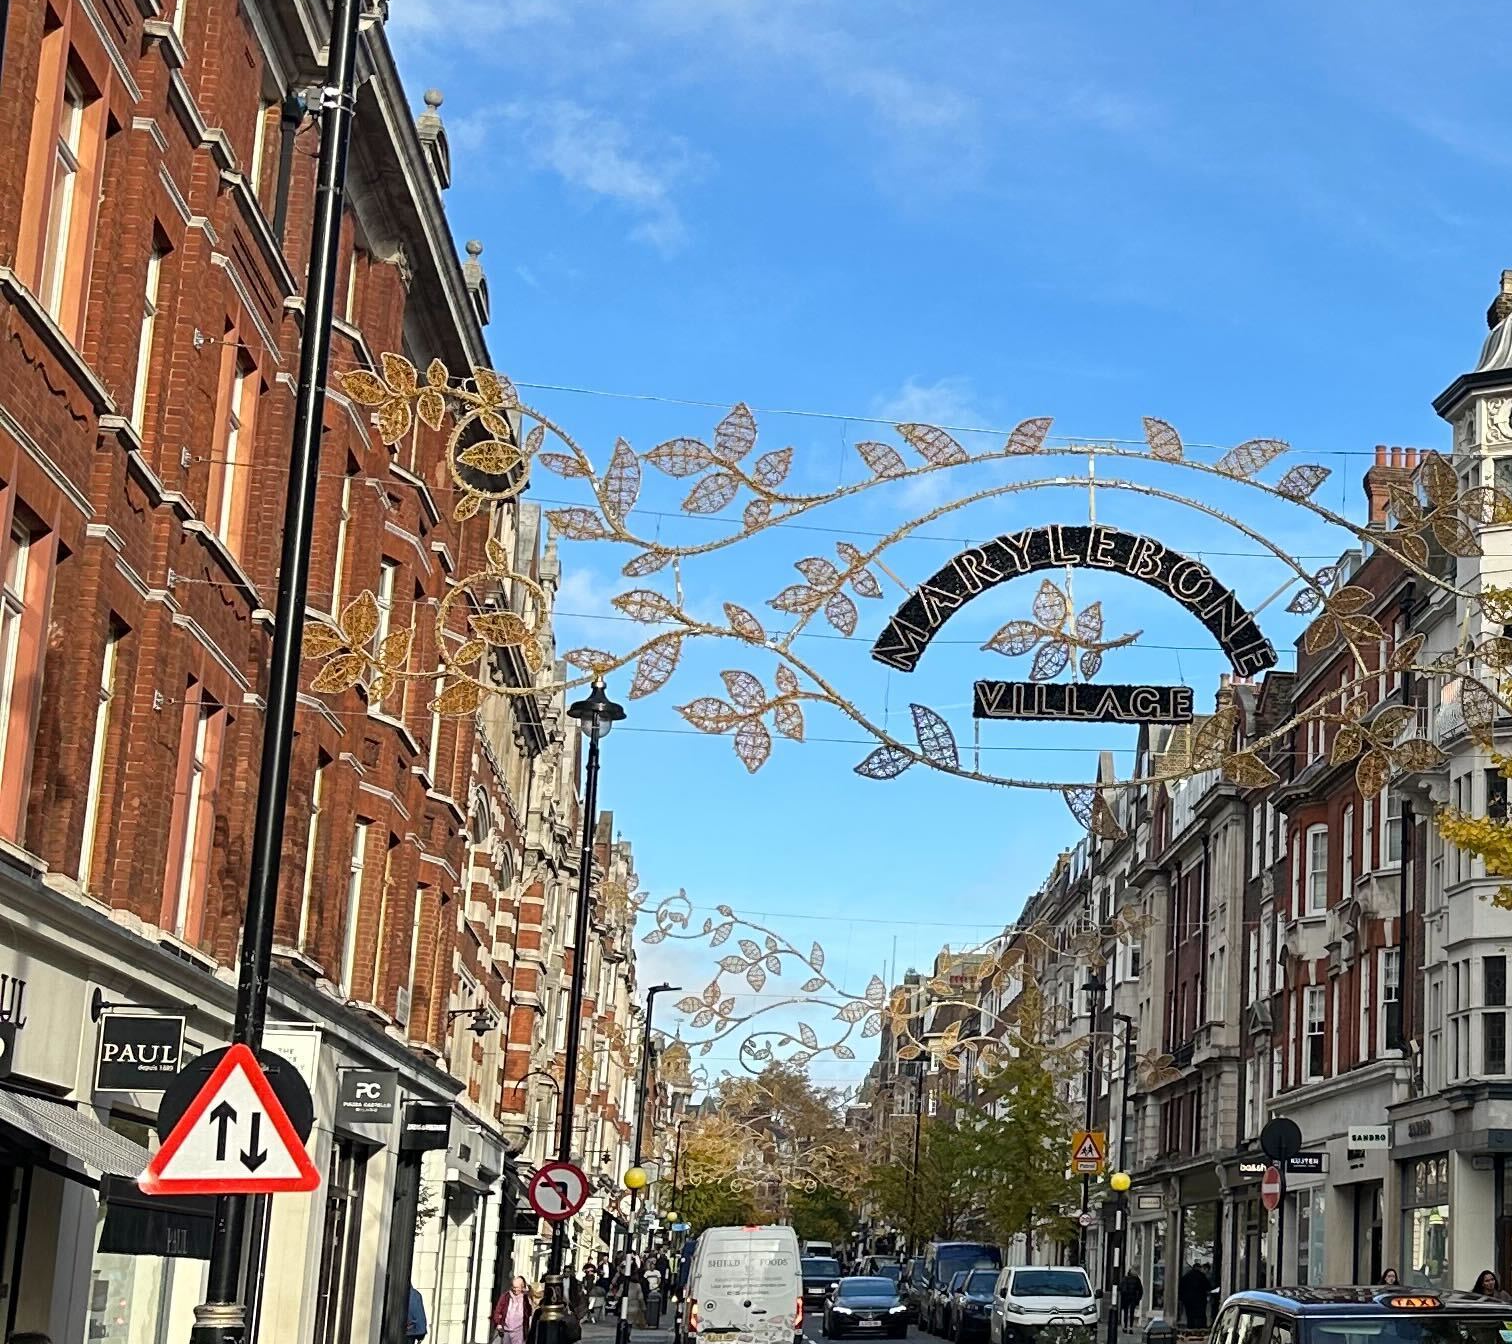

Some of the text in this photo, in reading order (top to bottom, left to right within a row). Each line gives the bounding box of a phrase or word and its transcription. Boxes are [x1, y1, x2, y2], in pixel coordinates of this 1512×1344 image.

[872, 524, 1279, 678] MARYLEBONE
[976, 681, 1193, 721] VILLAGE
[102, 1043, 178, 1063] PAUL
[1351, 1134, 1386, 1142] SANDRO
[1397, 1298, 1438, 1307] TAXI
